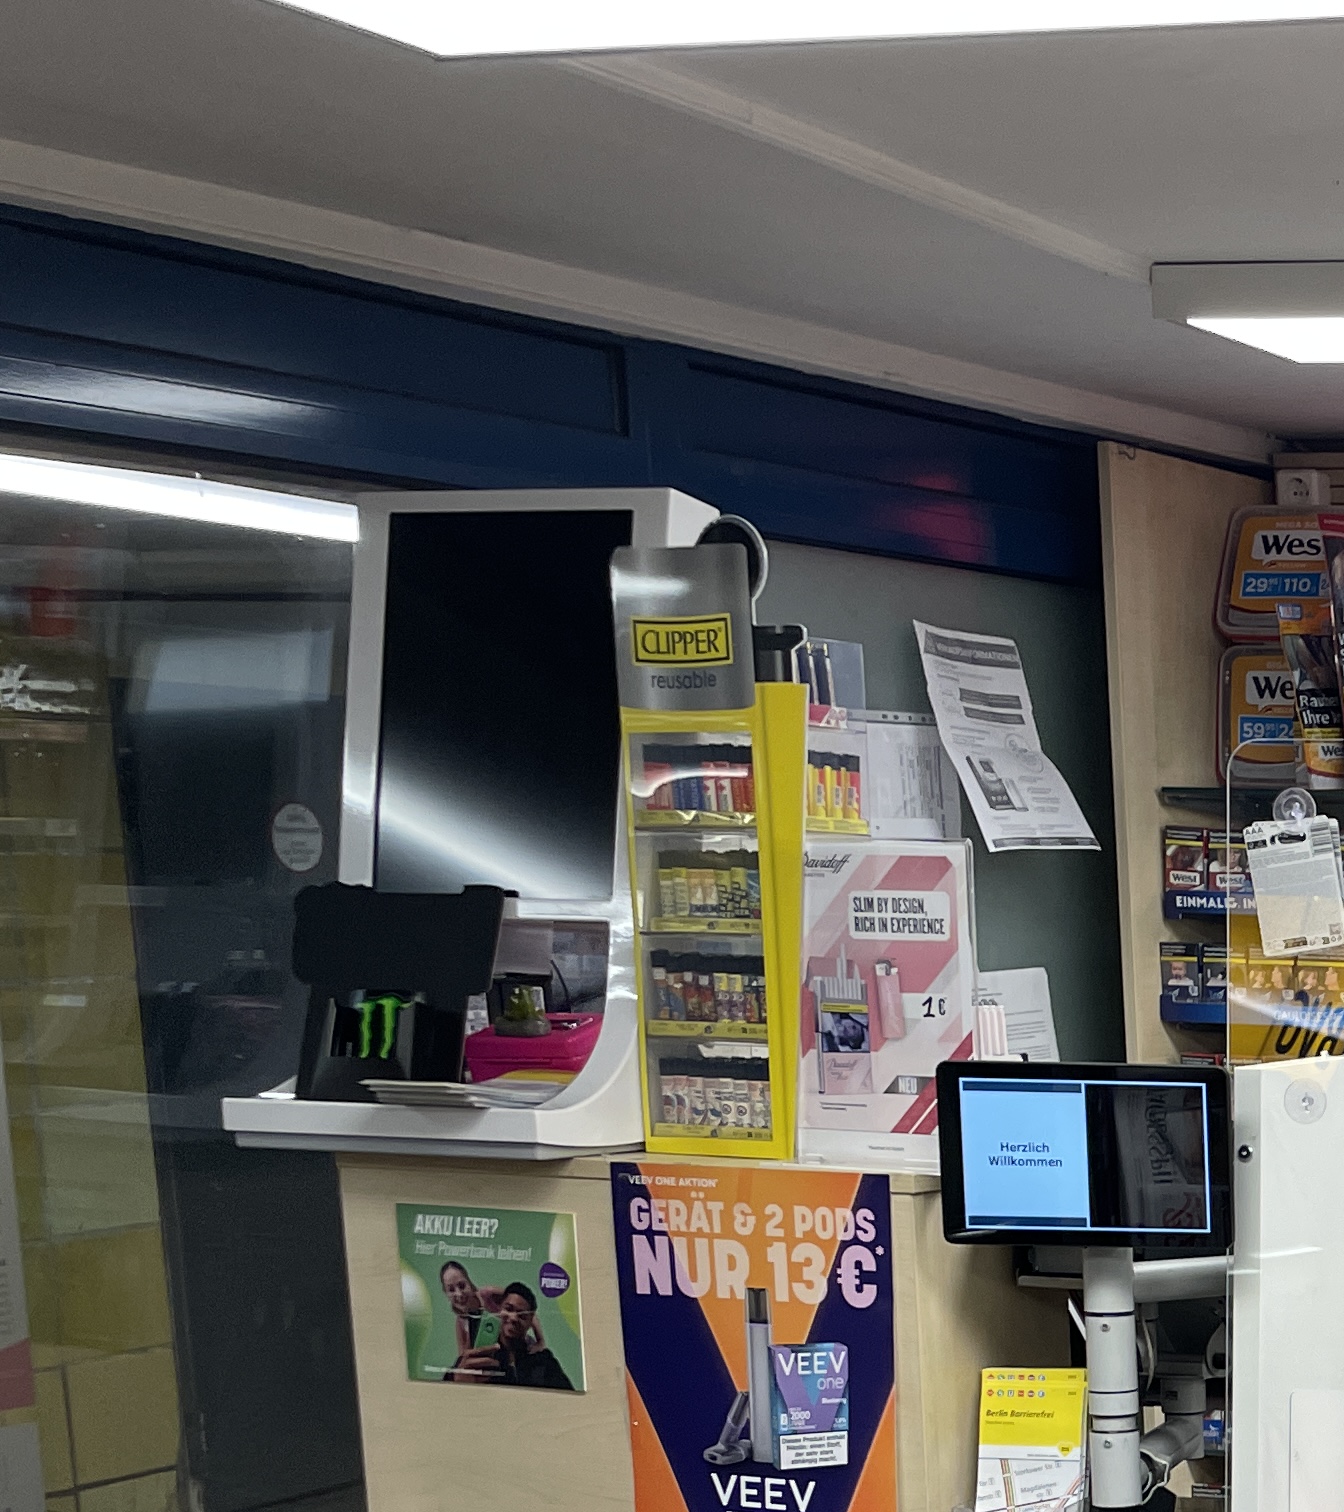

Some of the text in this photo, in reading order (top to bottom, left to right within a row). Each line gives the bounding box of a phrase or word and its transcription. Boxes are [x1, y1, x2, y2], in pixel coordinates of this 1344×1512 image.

[640, 628, 720, 656] CLIPPER
[650, 671, 717, 690] reusable
[853, 896, 927, 916] SLIM BY DESIGN,
[854, 916, 945, 934] RICH IN EXPERIENCE
[999, 1141, 1050, 1154] Herzlich
[988, 1155, 1063, 1168] Willkommen
[628, 1175, 652, 1185] VEEV
[655, 1176, 676, 1186] ONE
[414, 1214, 499, 1238] AKKU LEER?
[630, 1191, 876, 1242] GERÄT & 2 PODS
[415, 1239, 532, 1261] Hier Powerbank leihen!
[632, 1235, 749, 1299] NUR
[778, 1351, 846, 1376] VEEV
[817, 1377, 844, 1390] one
[710, 1474, 815, 1512] VEEV
